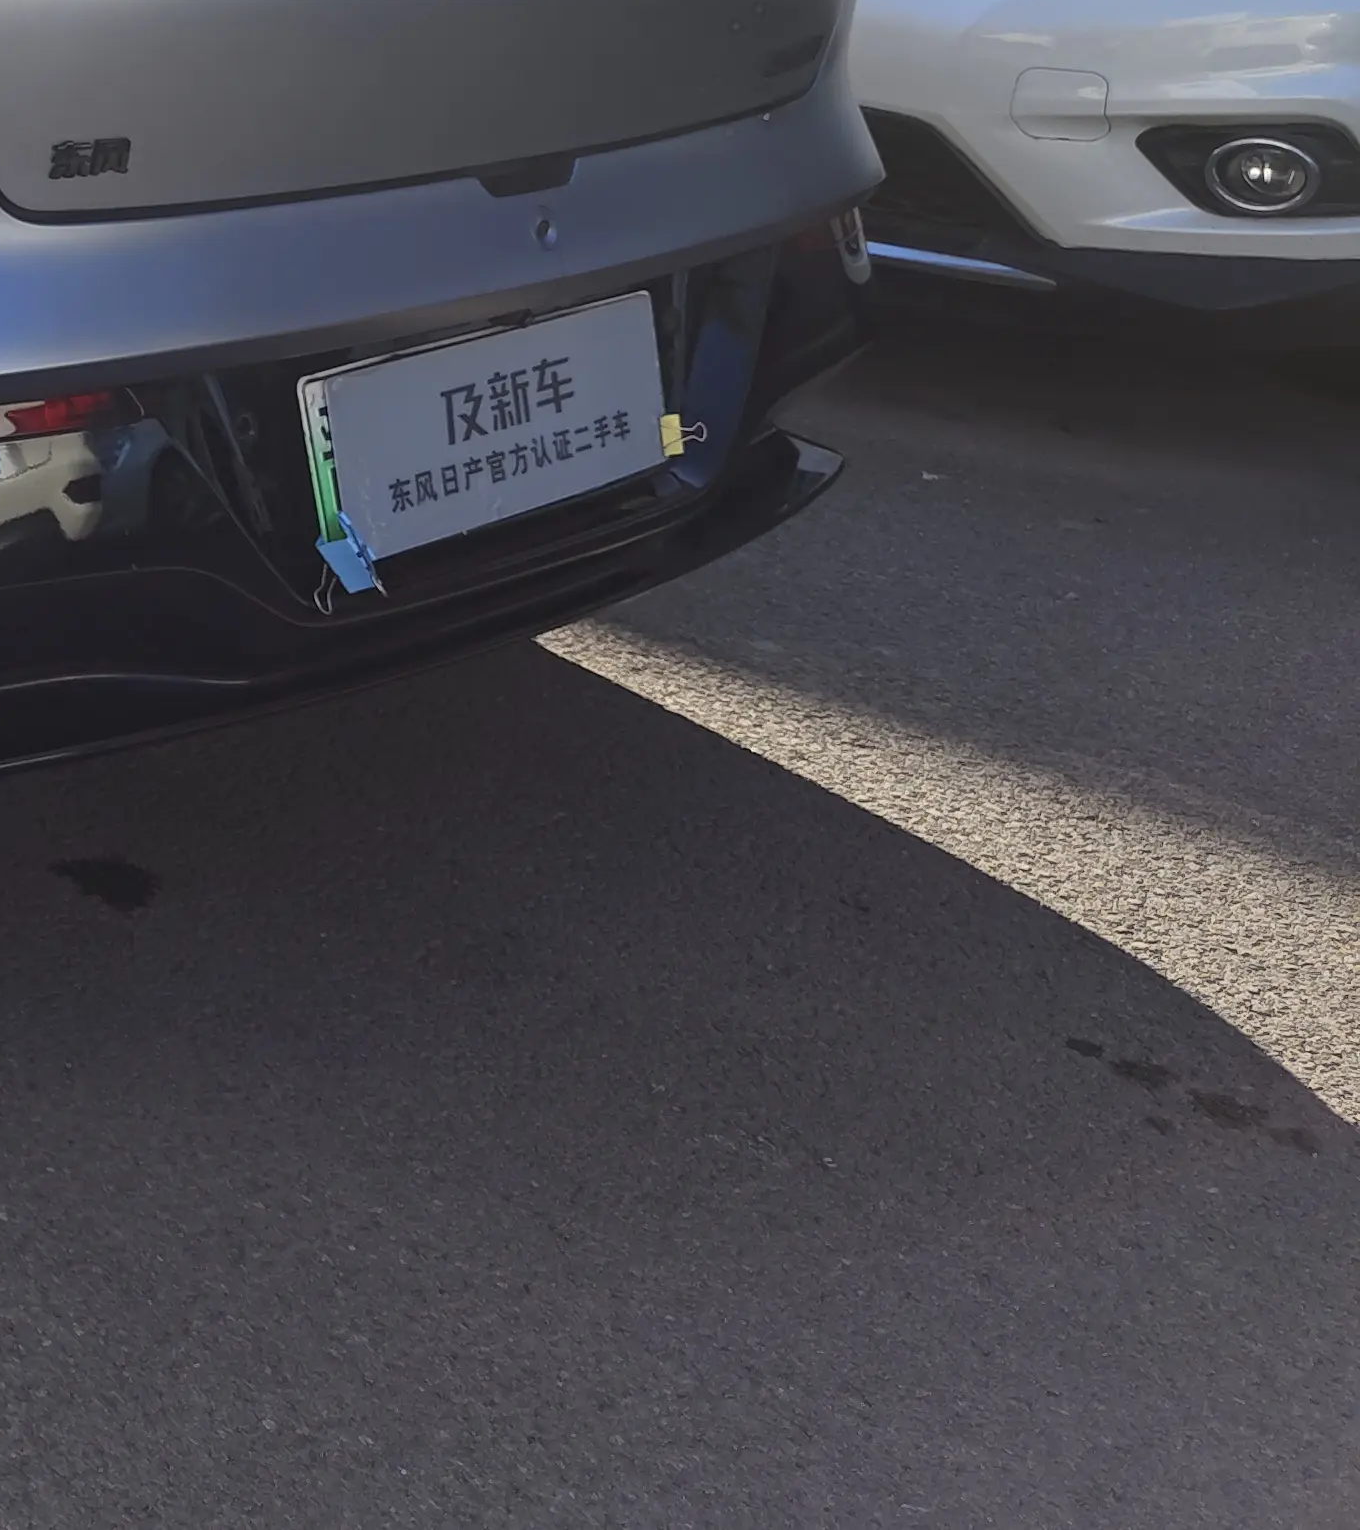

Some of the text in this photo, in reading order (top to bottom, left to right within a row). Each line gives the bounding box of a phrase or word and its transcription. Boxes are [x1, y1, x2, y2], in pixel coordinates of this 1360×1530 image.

[48, 137, 131, 179] 东风
[440, 356, 575, 446] 及新车
[389, 410, 631, 512] 东风日产官方认证二手车
